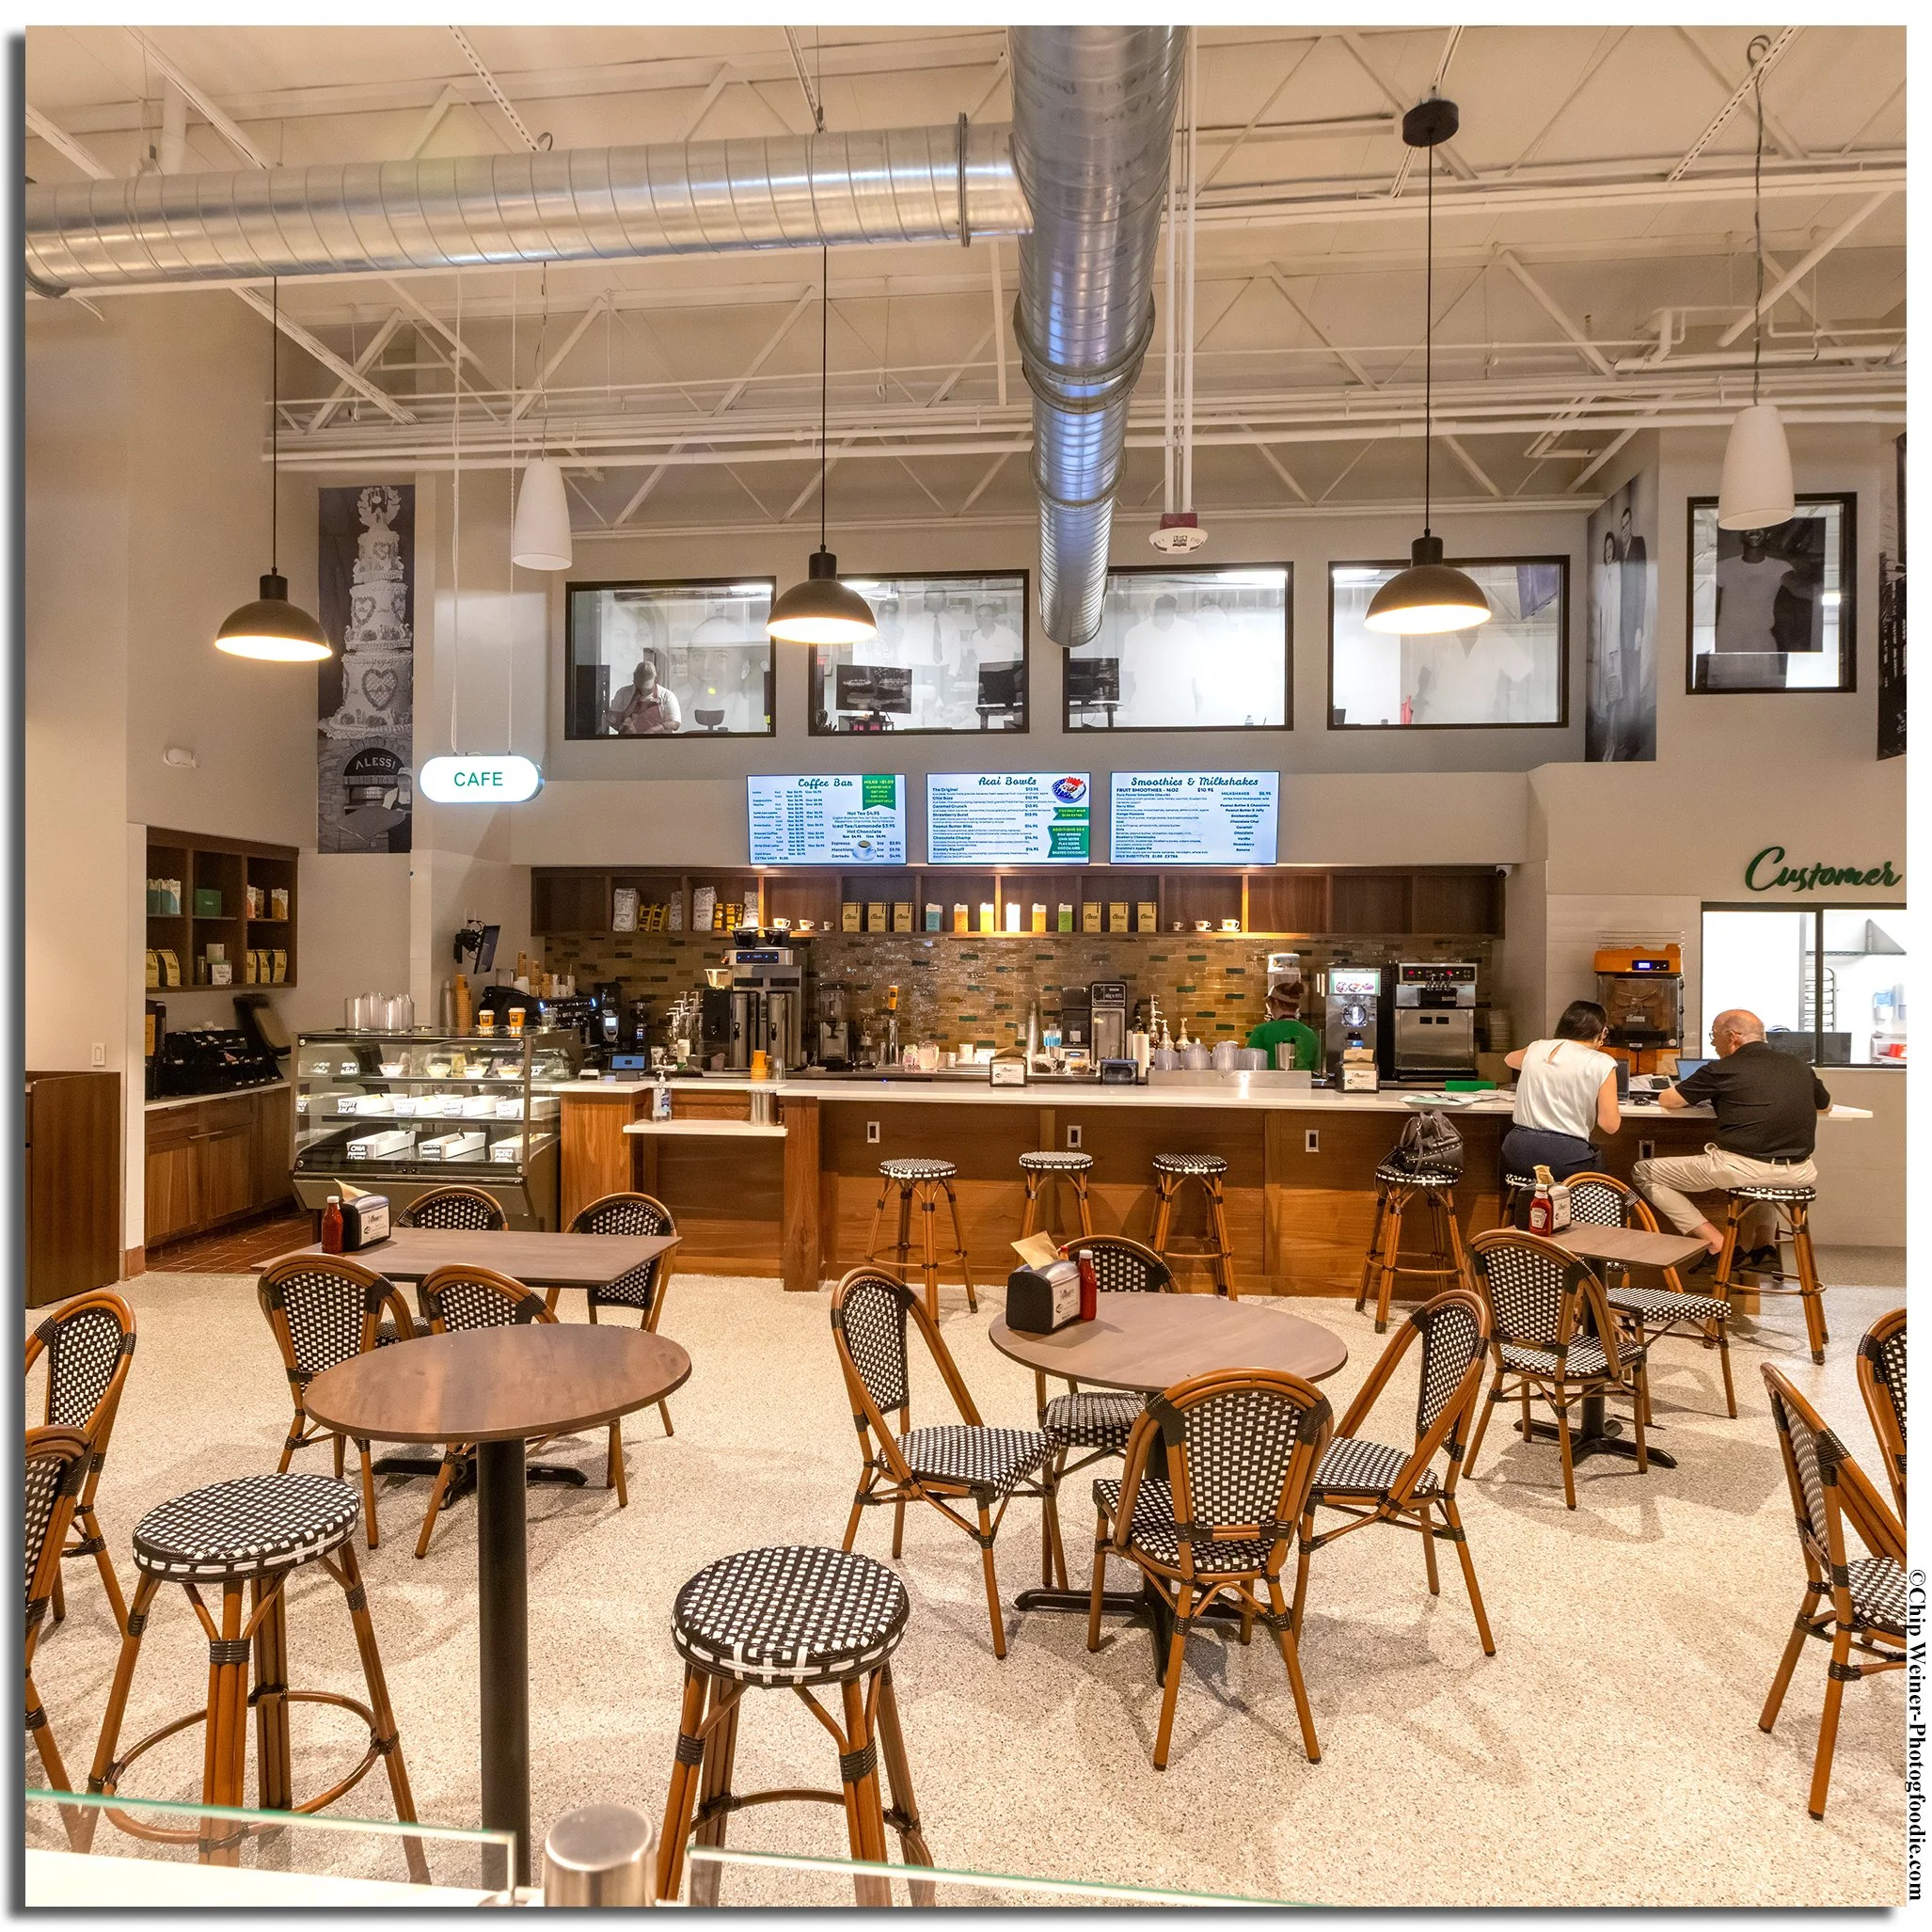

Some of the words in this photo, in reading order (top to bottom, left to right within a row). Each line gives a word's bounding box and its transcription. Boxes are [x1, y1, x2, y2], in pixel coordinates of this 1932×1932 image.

[356, 756, 396, 770] ALESSI
[453, 771, 503, 786] CAFE
[798, 778, 830, 789] Coffee
[833, 778, 853, 787] Bar
[978, 776, 1002, 785] Acai
[1005, 776, 1037, 785] Bowls
[1131, 777, 1183, 786] Smoothies
[1187, 777, 1196, 786] &
[1198, 777, 1259, 786] Milkshakes
[1745, 847, 1903, 892] Customer
